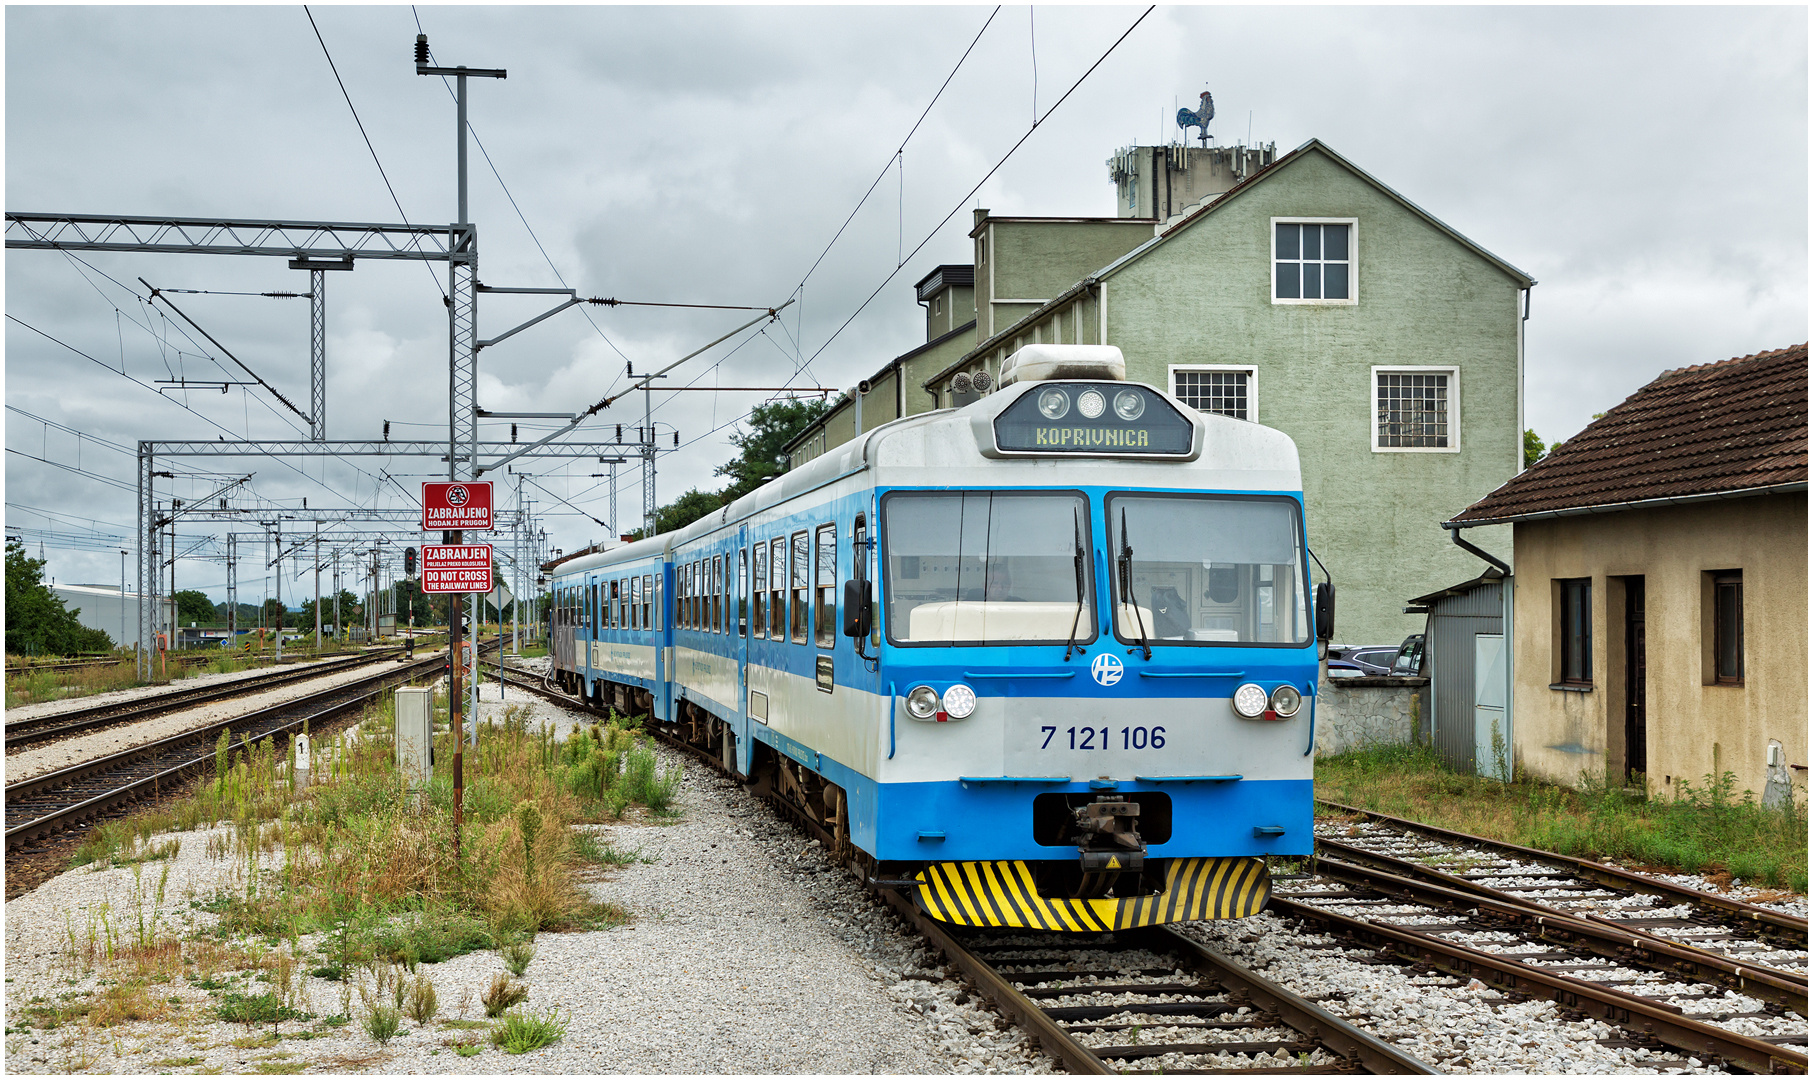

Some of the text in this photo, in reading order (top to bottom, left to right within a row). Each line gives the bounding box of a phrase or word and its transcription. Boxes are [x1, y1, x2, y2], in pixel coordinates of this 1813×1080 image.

[1036, 428, 1149, 447] KOPRIVNICA
[428, 508, 488, 519] ZABRANJENO
[426, 548, 487, 559] ZABRANJEN
[427, 570, 488, 582] DO NOT CROSS
[469, 581, 488, 589] LINES
[1041, 726, 1166, 750] 7 121 106
[298, 742, 303, 754] 1
